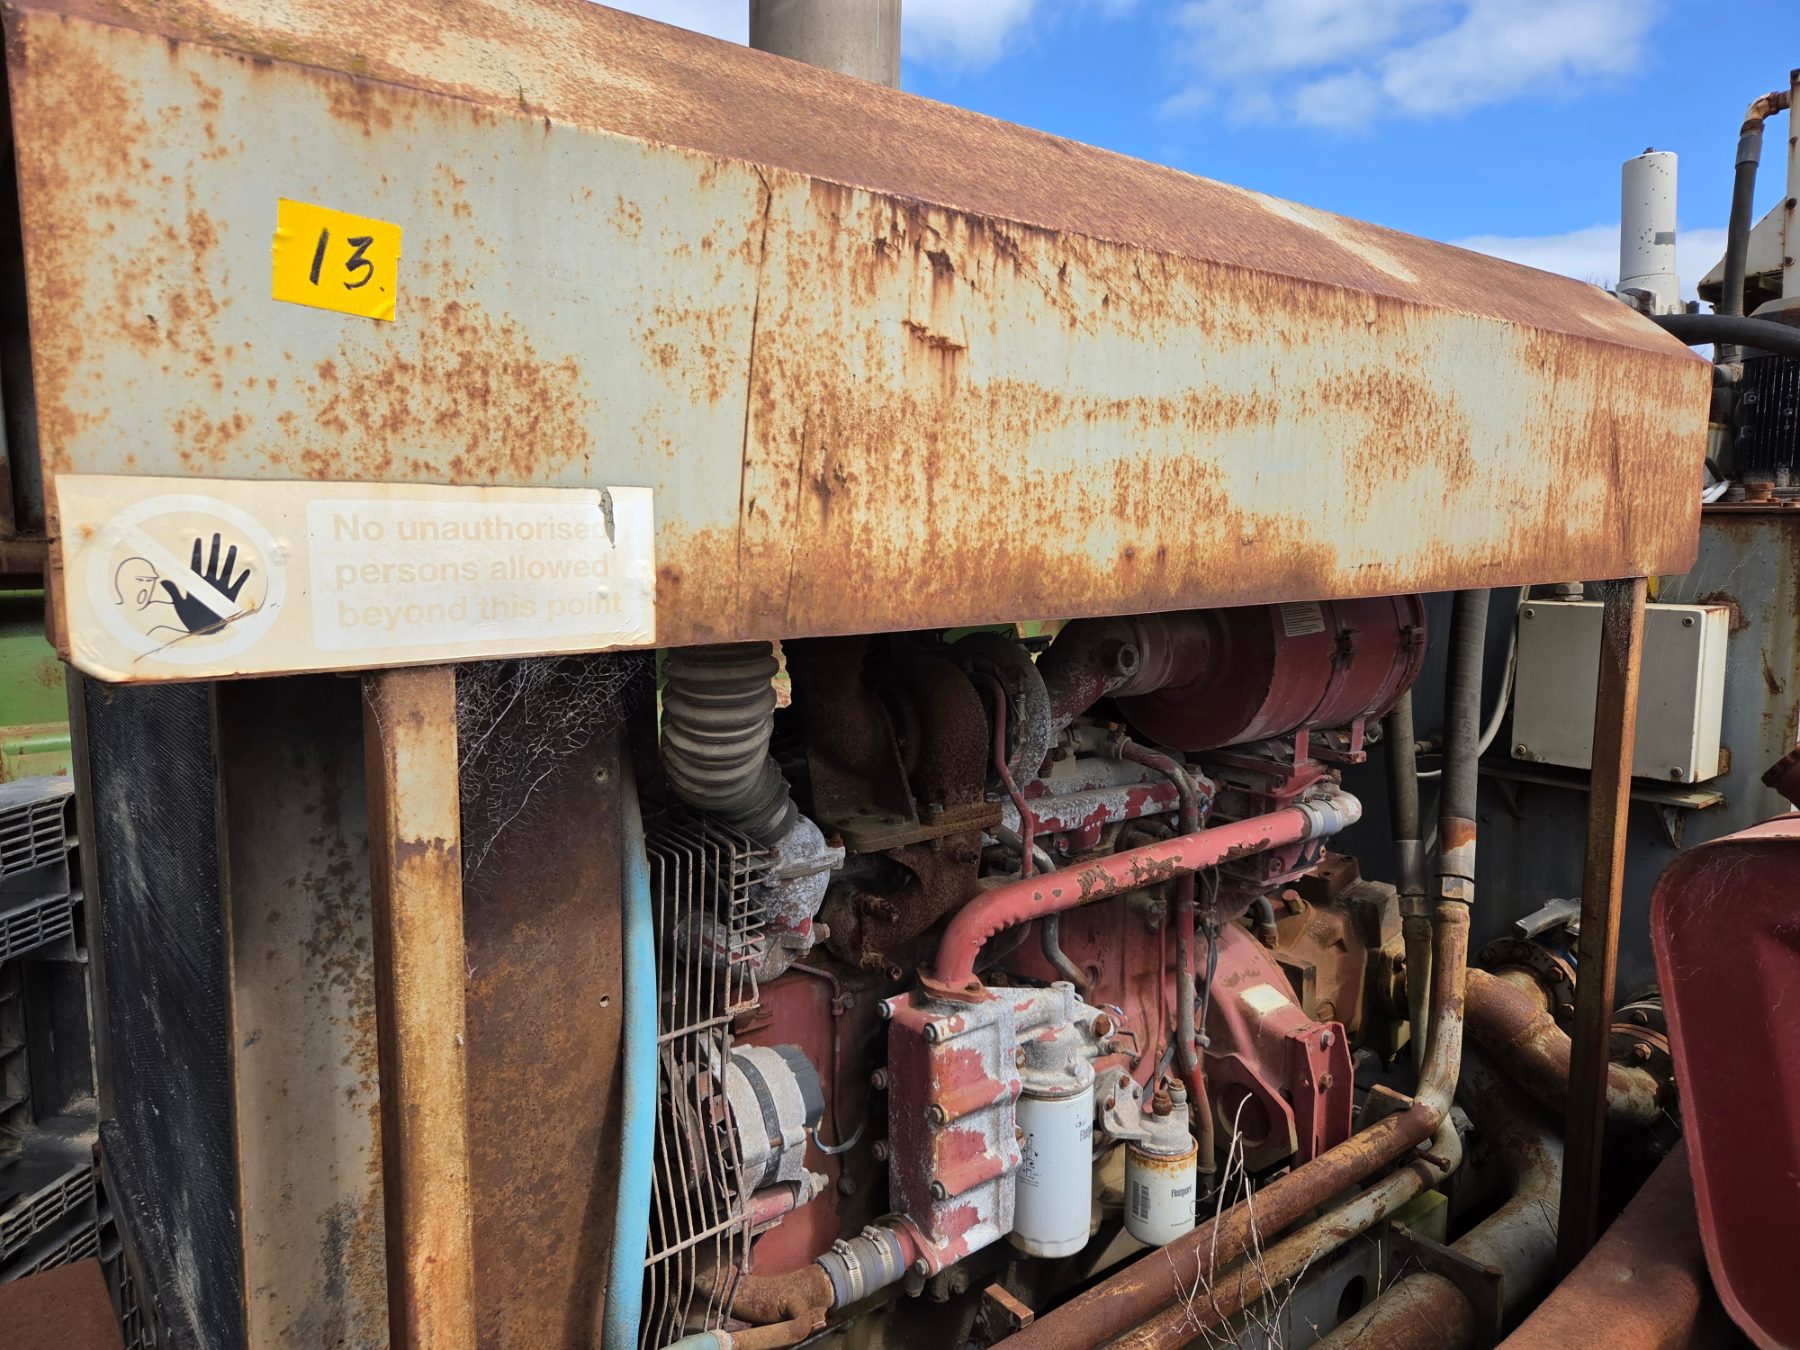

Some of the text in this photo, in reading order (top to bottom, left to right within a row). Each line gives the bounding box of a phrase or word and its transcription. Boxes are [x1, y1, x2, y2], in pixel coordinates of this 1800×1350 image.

[332, 512, 385, 541] No
[335, 553, 609, 592] persons allowed
[337, 591, 623, 631] beyond this point
